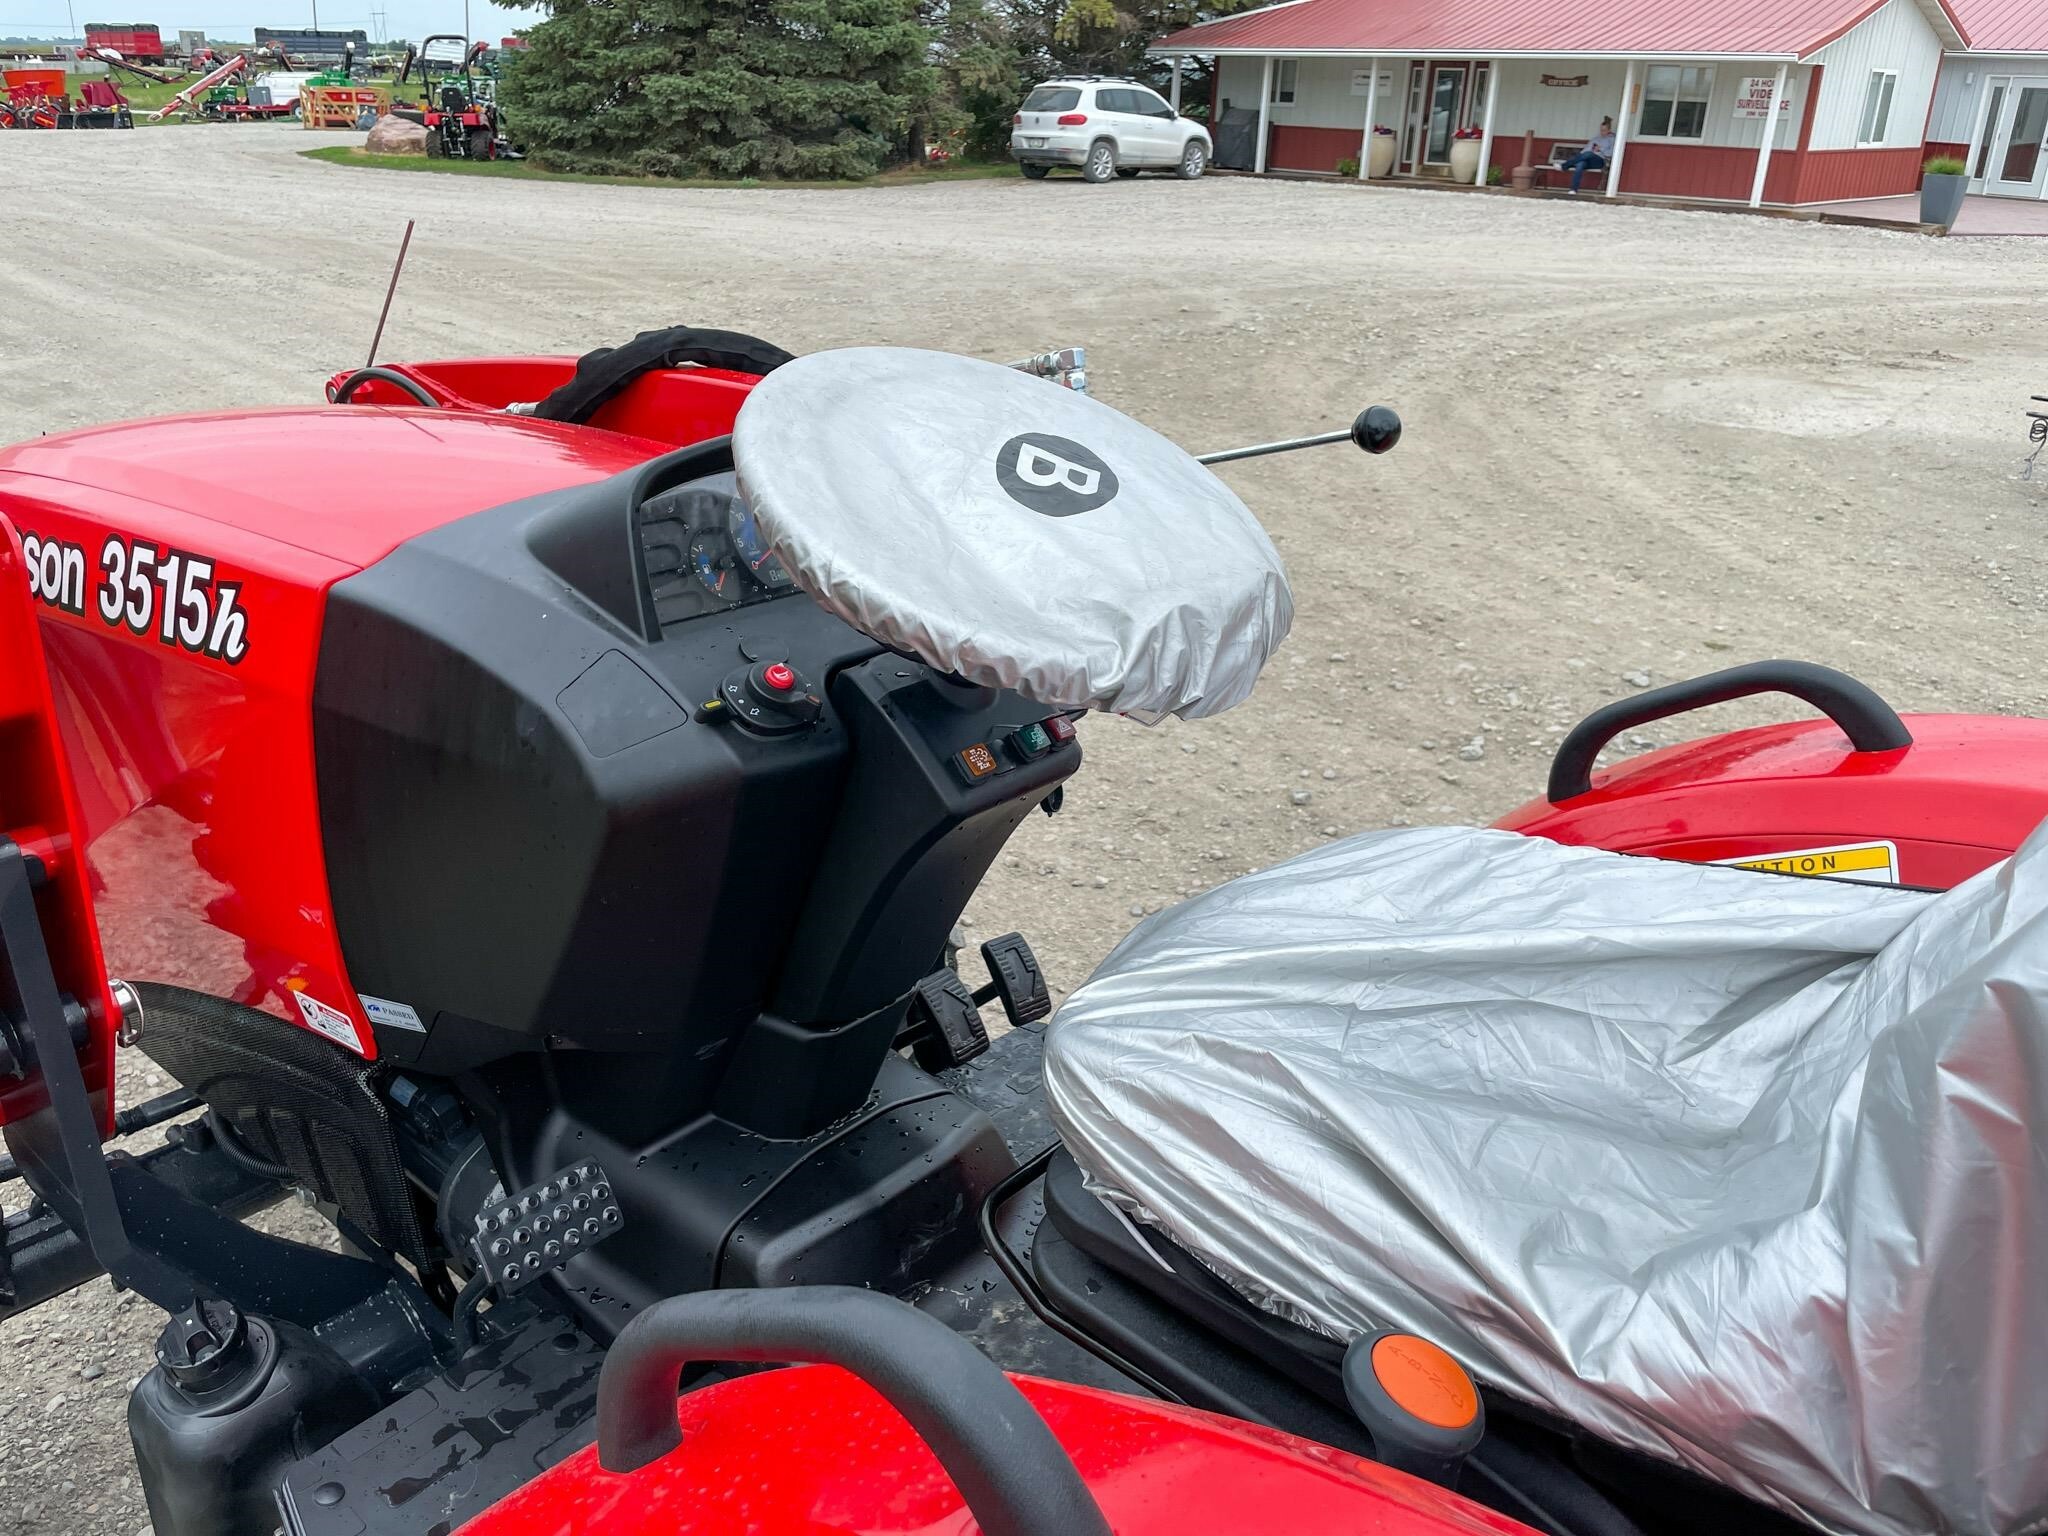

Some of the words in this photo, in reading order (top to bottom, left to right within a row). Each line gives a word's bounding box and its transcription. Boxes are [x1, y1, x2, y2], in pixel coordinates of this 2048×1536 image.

[1750, 79, 1759, 87] 24
[1750, 89, 1773, 98] VIDE
[1737, 99, 1790, 110] SURVEILLCE
[1015, 442, 1101, 495] B
[735, 511, 745, 521] 10
[737, 538, 744, 547] 5
[17, 530, 85, 611] son
[99, 539, 245, 659] 3515h
[1752, 856, 1835, 872] TION
